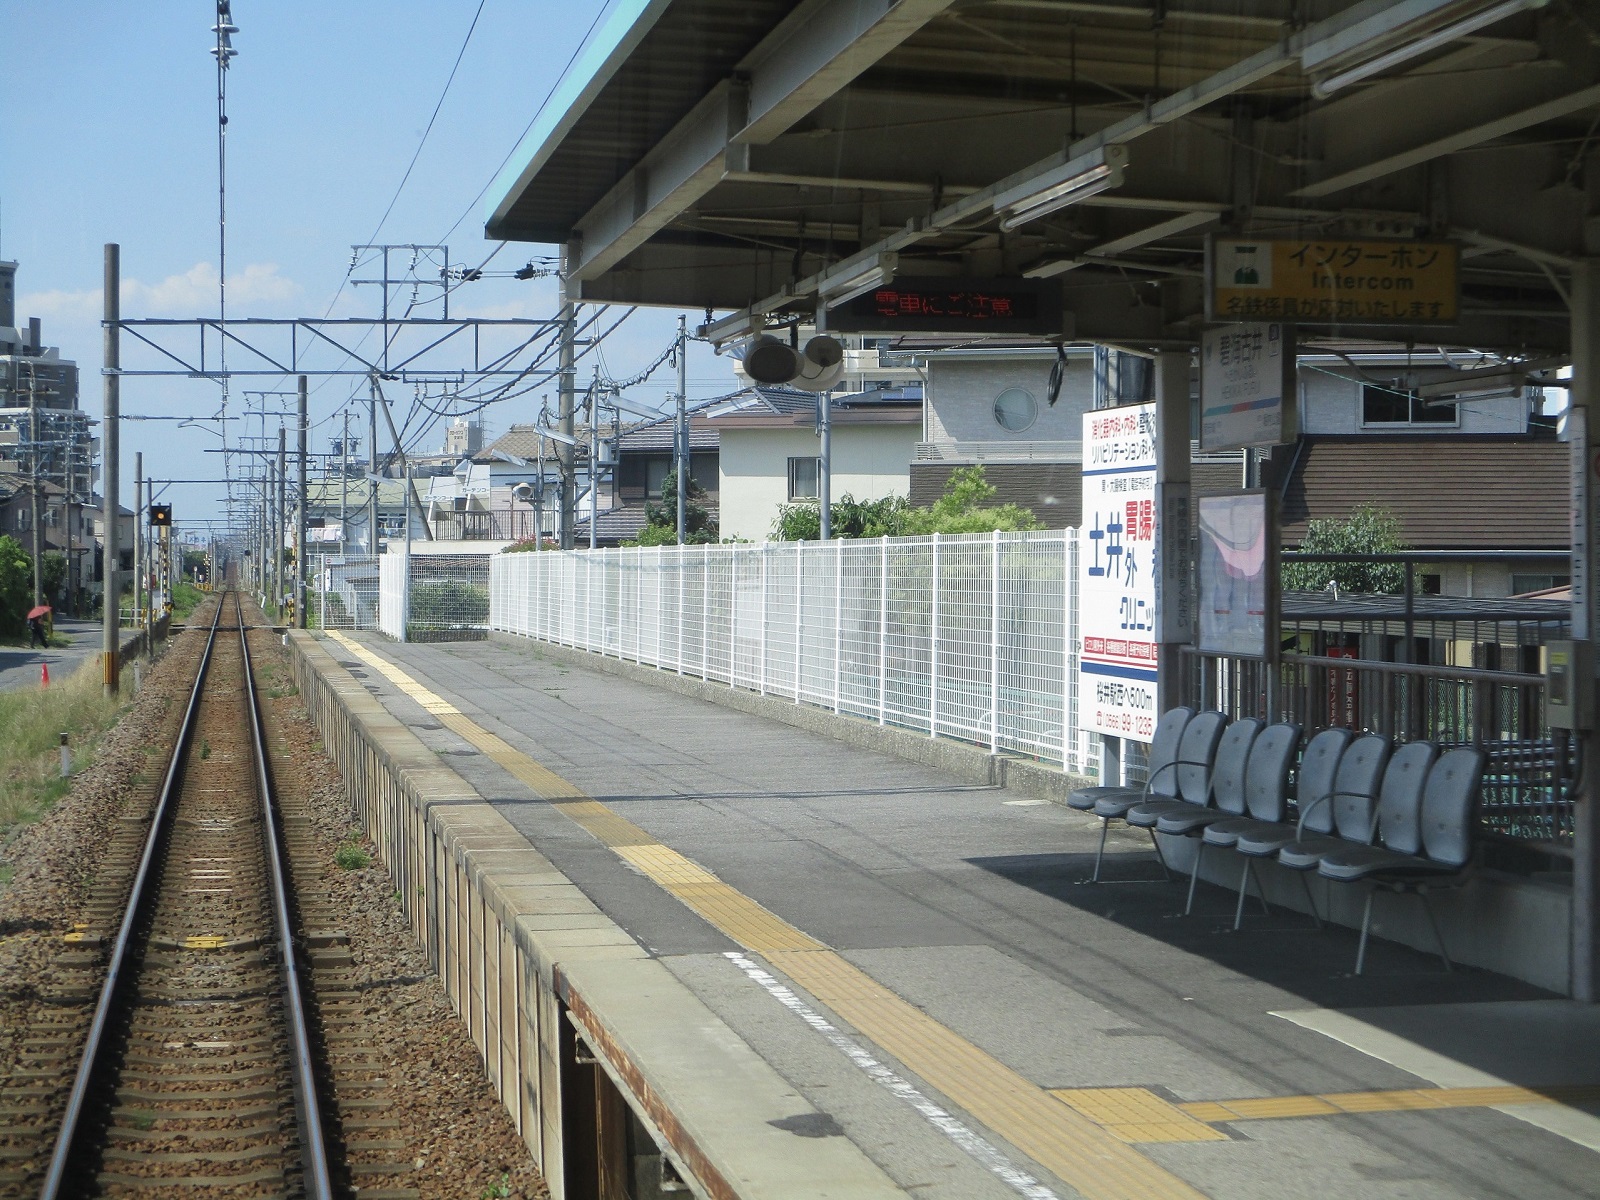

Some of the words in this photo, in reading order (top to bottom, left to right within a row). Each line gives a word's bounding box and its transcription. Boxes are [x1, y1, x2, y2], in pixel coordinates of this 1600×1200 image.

[1289, 243, 1439, 269] インターホン
[1311, 271, 1415, 291] Intercom
[875, 290, 1013, 318] 電車にご注意
[1226, 296, 1444, 318] 名鉄係員が応対いたします
[1125, 499, 1156, 542] 胃腸
[1088, 510, 1123, 579] 土井
[1097, 680, 1152, 710] 桜井駅西へ500m
